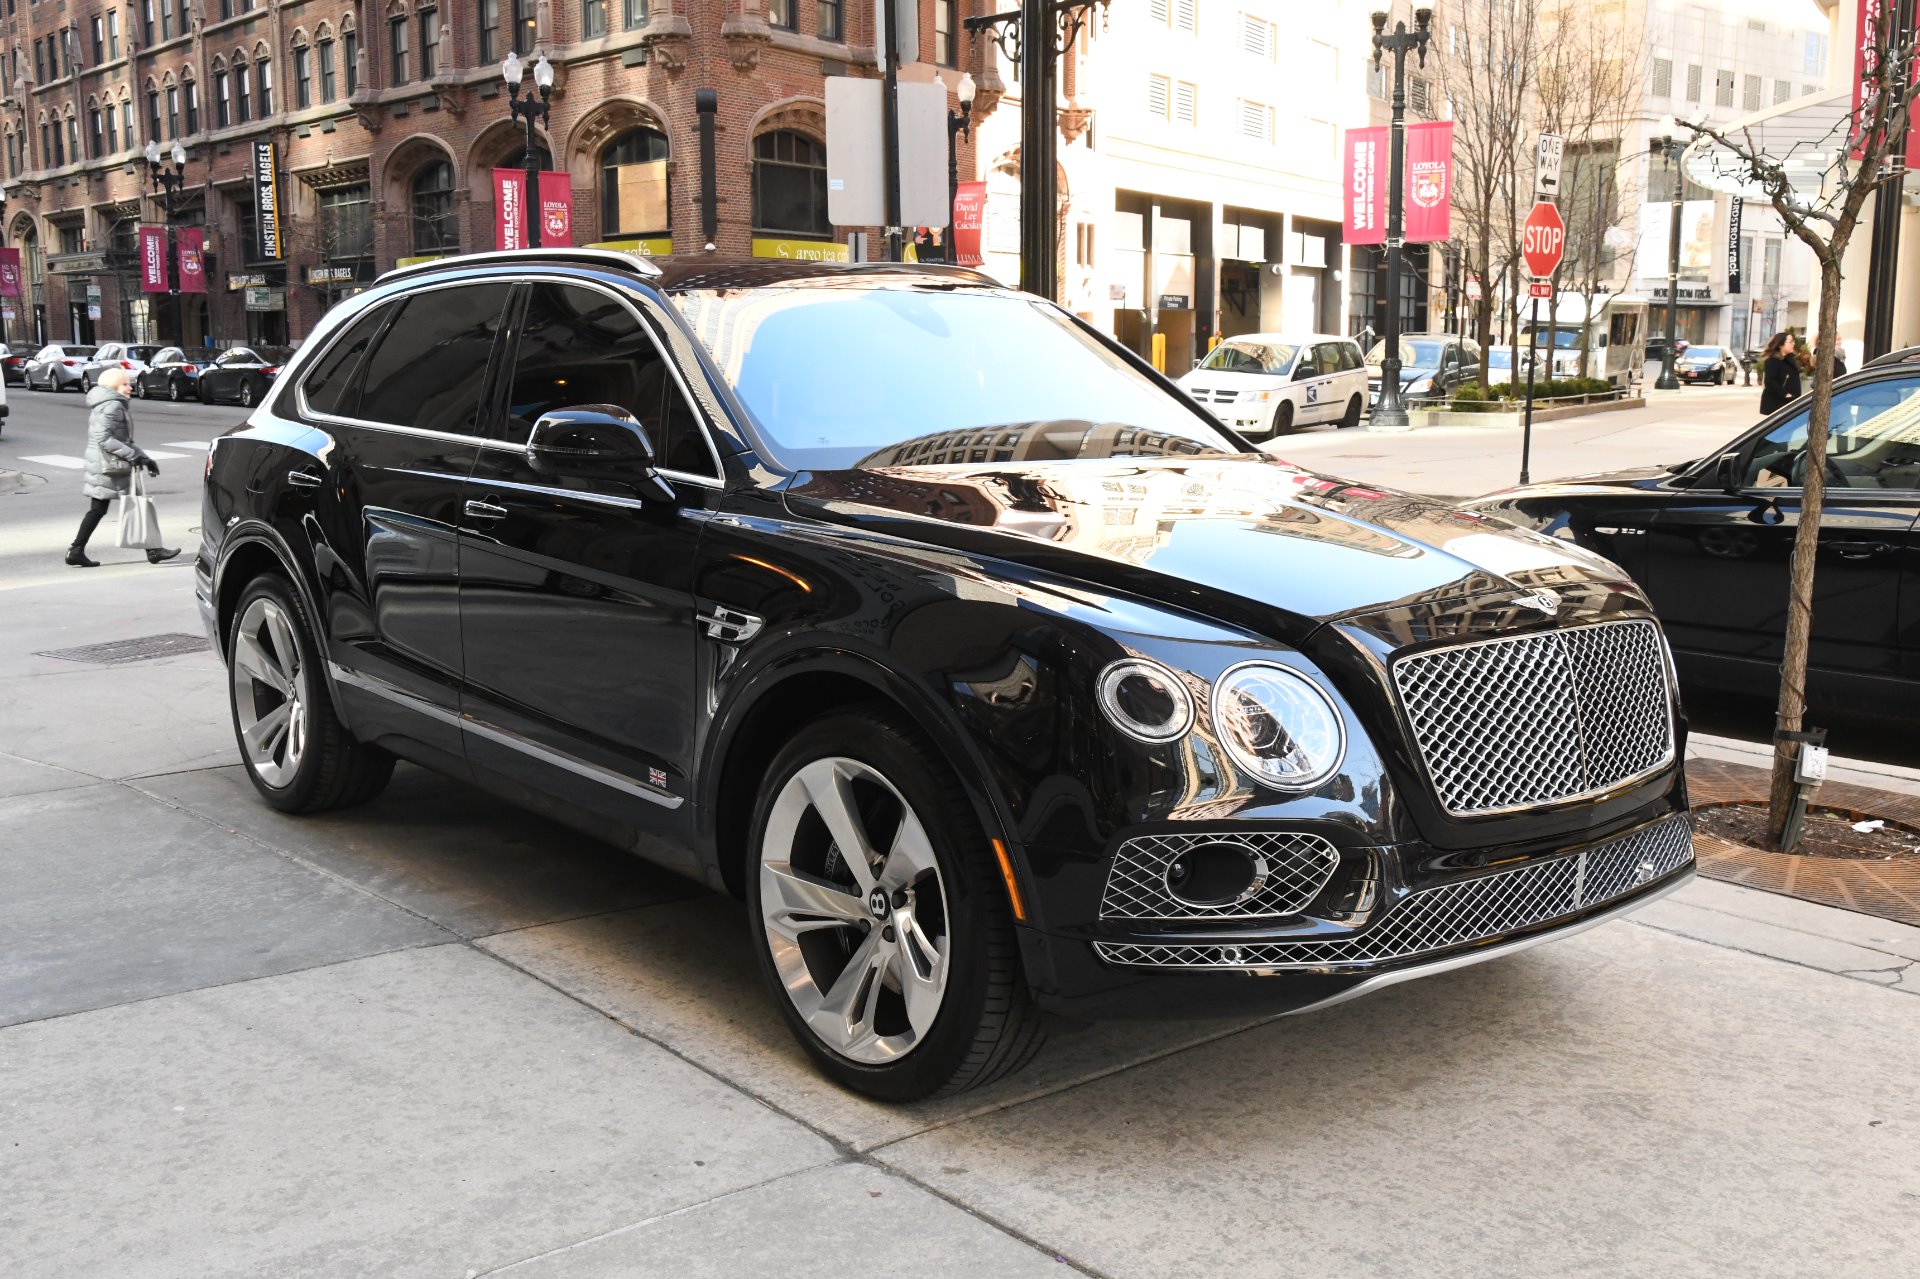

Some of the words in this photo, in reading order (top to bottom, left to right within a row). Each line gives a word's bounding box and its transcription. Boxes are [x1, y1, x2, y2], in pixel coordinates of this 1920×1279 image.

[1367, 141, 1376, 174] CAMPUS
[1541, 139, 1560, 155] ONE
[259, 144, 272, 182] BAGELS
[1412, 161, 1446, 171] LOYOLA
[1540, 155, 1559, 171] WAY
[261, 184, 274, 211] BROS.
[1353, 141, 1367, 230] WELCOME
[502, 180, 513, 250] WELCOME
[956, 202, 978, 212] David
[964, 211, 977, 220] Lee
[263, 213, 276, 257] EINSTEIN
[1729, 196, 1741, 249] ORDSTROM
[1525, 225, 1562, 255] STOP
[146, 235, 157, 284] WELCOME
[822, 248, 836, 262] tea
[1729, 251, 1740, 276] rack
[334, 267, 352, 278] BAGELS
[1531, 285, 1540, 295] ALL
[1541, 285, 1550, 296] WAY
[1653, 287, 1693, 298] NORROM
[1694, 285, 1711, 299] rack
